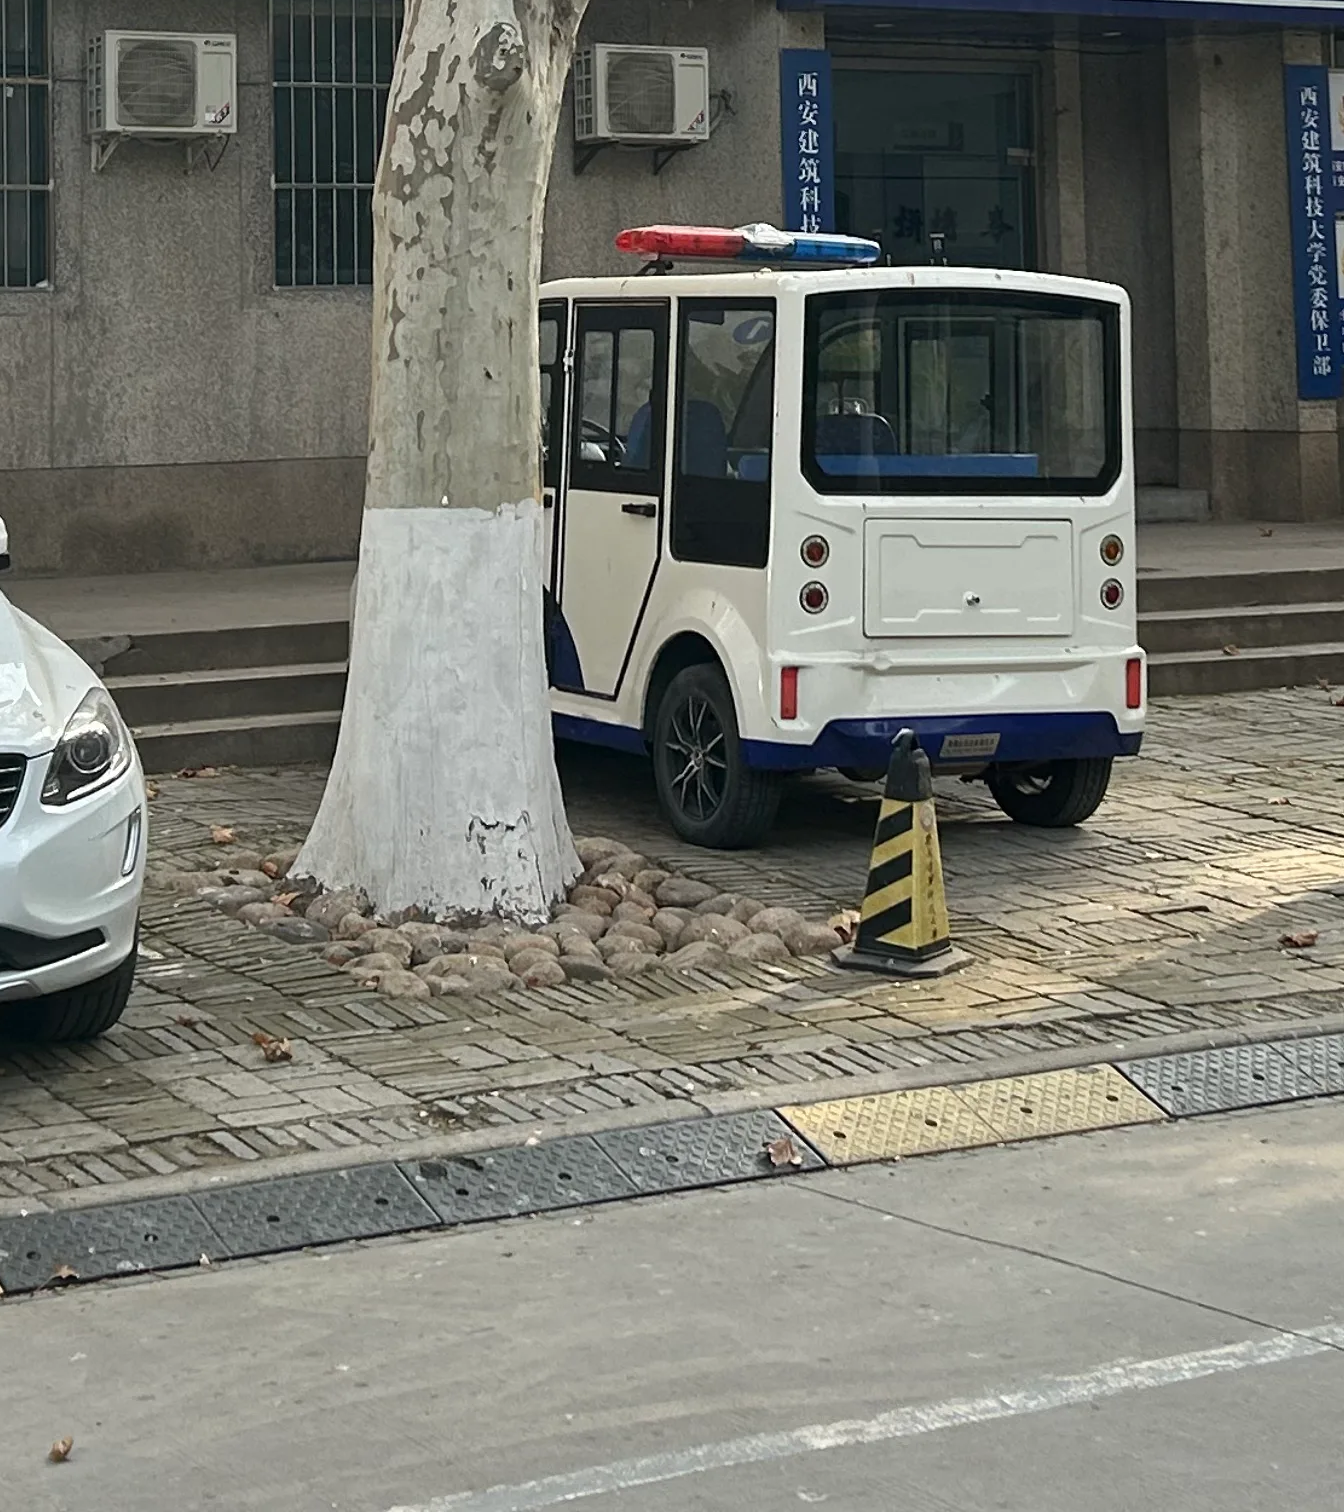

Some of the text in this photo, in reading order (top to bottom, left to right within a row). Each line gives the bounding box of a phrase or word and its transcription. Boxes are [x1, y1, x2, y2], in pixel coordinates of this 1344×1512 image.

[1300, 85, 1332, 376] 西安建筑科技大学党委保卫部
